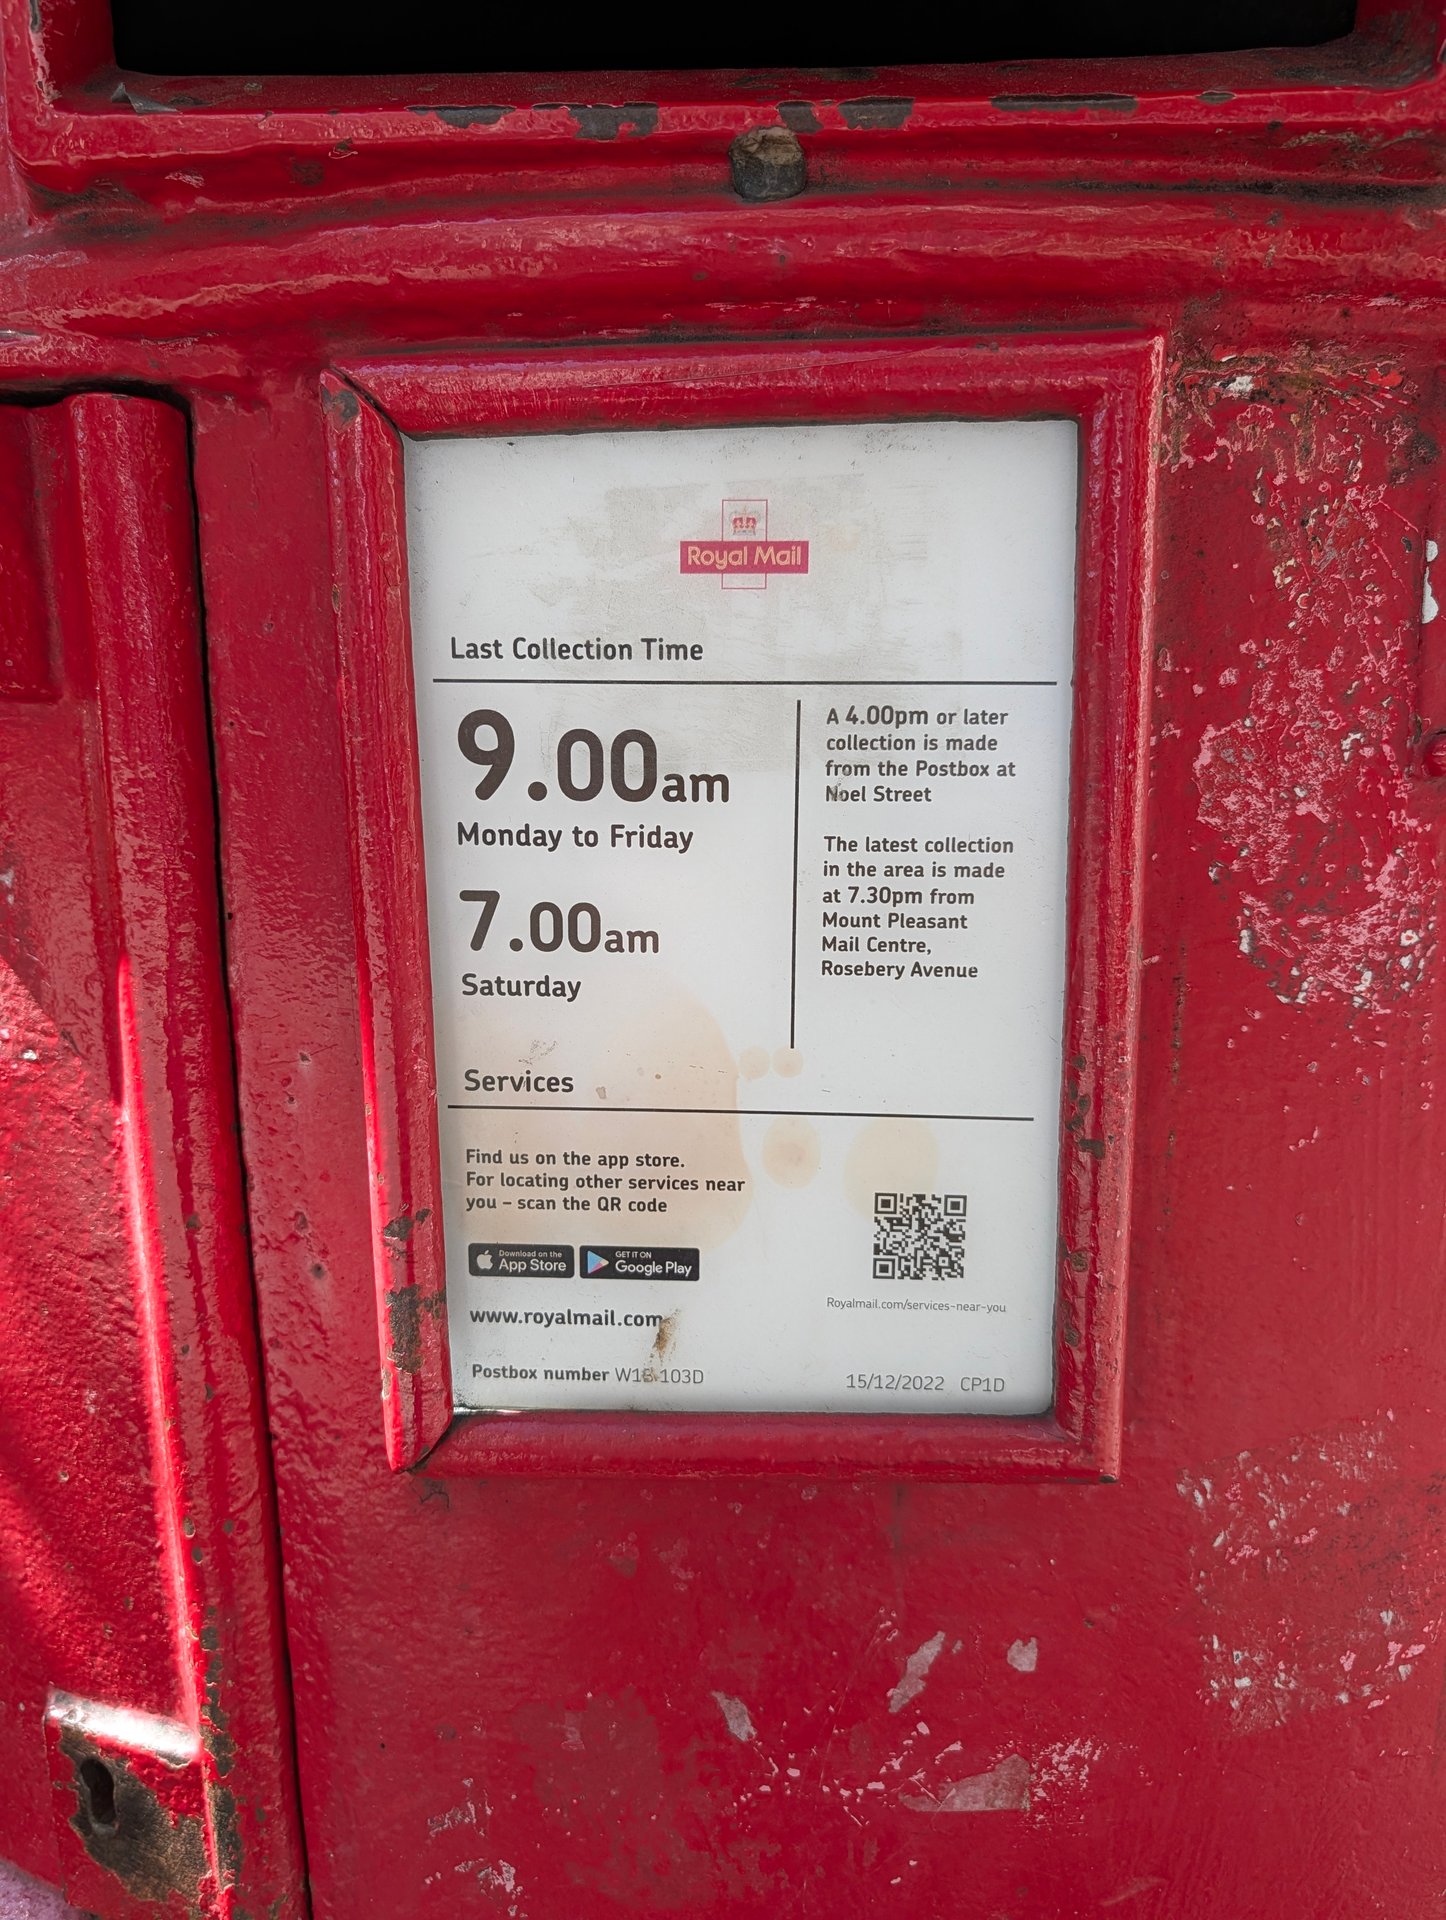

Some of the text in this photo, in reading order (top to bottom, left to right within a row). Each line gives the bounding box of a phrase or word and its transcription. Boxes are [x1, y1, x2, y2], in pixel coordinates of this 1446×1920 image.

[687, 546, 801, 570] Royal Mail
[451, 637, 703, 660] Last Collection Time
[827, 705, 1008, 729] A 4.00pm or later
[827, 734, 997, 751] collection is made
[458, 709, 729, 803] 9.00am
[825, 760, 1016, 777] from the Postbox at
[826, 785, 932, 802] Noel Street
[458, 822, 693, 854] Monday to Friday
[824, 836, 1013, 853] The latest collection
[824, 861, 1005, 878] in the area is made
[823, 886, 974, 907] at 7.30pm from
[459, 890, 659, 953] 7.00am
[823, 912, 968, 929] Mount Pleasant
[822, 936, 932, 955] Mail Centre,
[822, 960, 978, 980] Rosebery Avenue
[462, 973, 581, 1002] Saturday
[465, 1069, 573, 1093] Services
[467, 1149, 684, 1169] Find us on the app store.
[467, 1172, 746, 1191] For locating other services near
[466, 1197, 497, 1212] you
[518, 1199, 556, 1210] scan
[563, 1196, 590, 1210] the
[598, 1196, 621, 1211] QR
[629, 1198, 667, 1212] code
[499, 1250, 537, 1258] Download
[639, 1252, 652, 1260] ON
[499, 1259, 567, 1272] App Store
[615, 1259, 692, 1277] Google Play
[827, 1297, 1006, 1313] Royalmail.com/services-near-you
[470, 1309, 663, 1328] www.royalmail.com
[473, 1364, 537, 1379] Postbox
[544, 1367, 609, 1381] number
[660, 1369, 703, 1383] 103D
[847, 1374, 1004, 1392] 15/12/2022 CP1D
